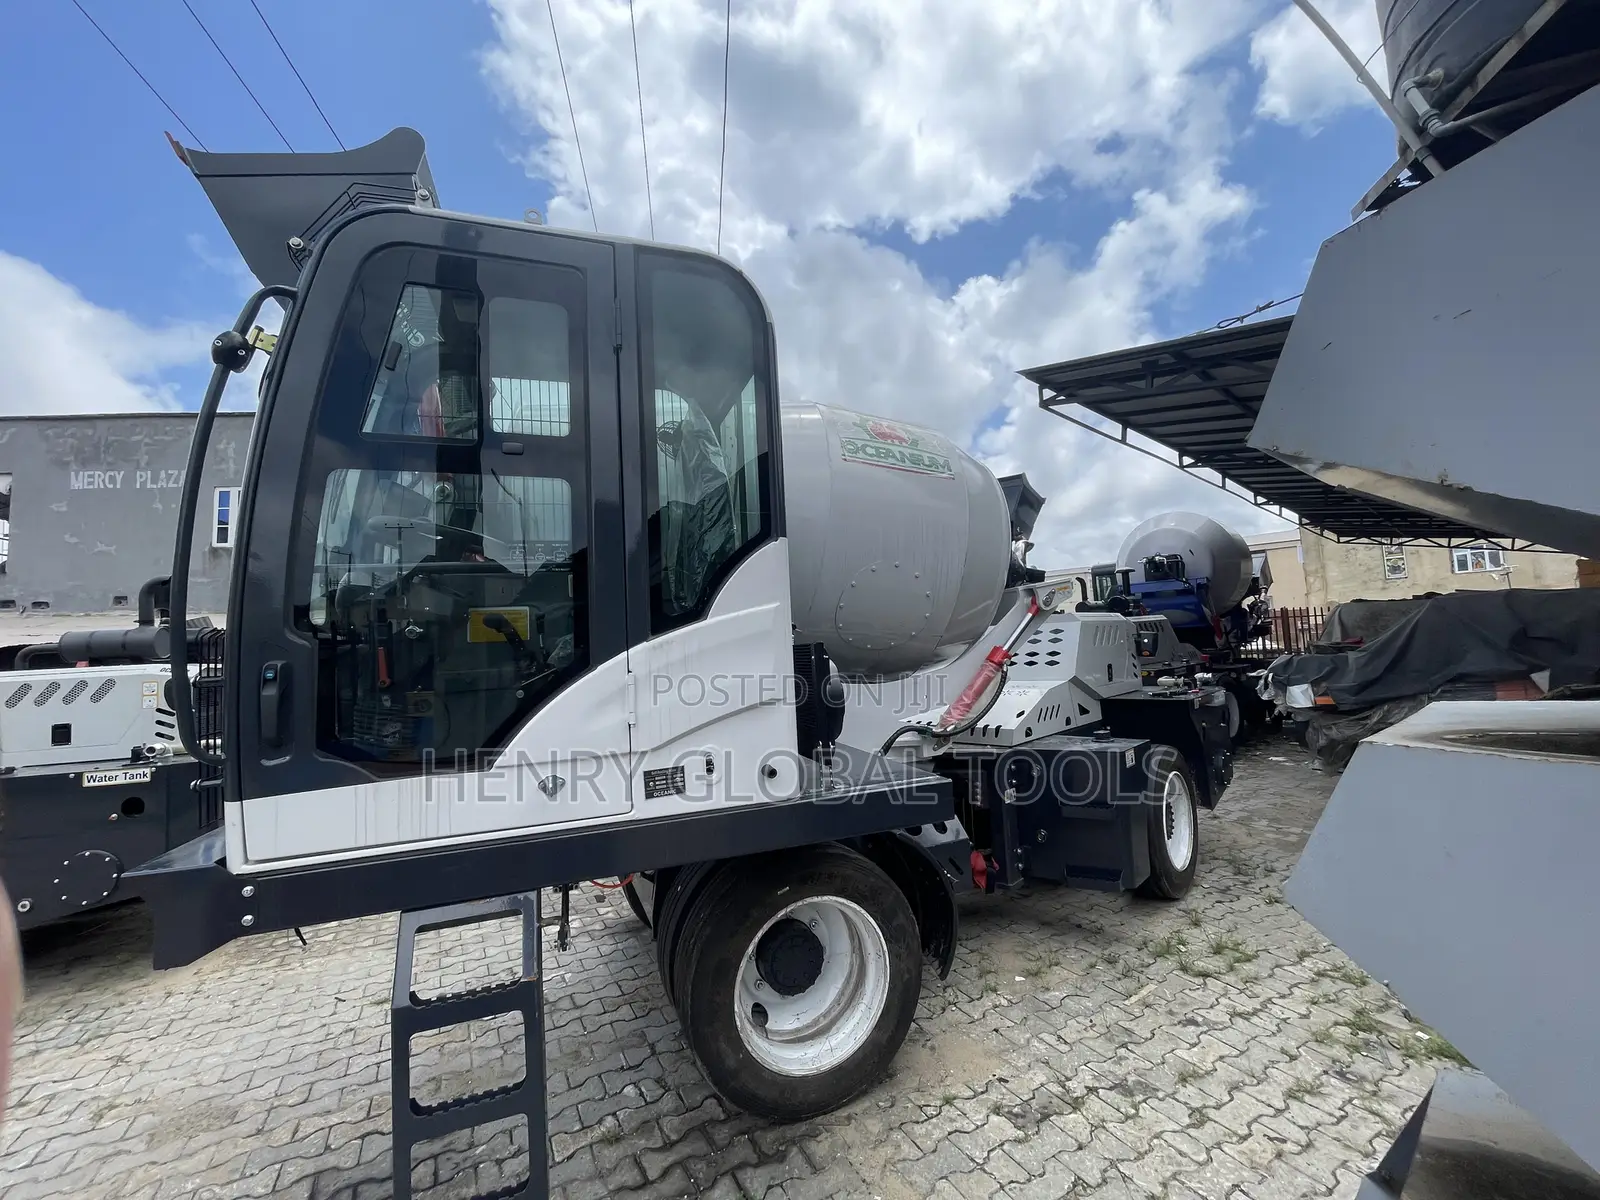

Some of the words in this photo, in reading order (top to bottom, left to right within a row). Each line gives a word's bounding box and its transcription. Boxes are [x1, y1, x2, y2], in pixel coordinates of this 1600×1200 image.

[70, 470, 124, 490] MERCY
[86, 773, 119, 784] Water
[122, 770, 149, 781] Tank
